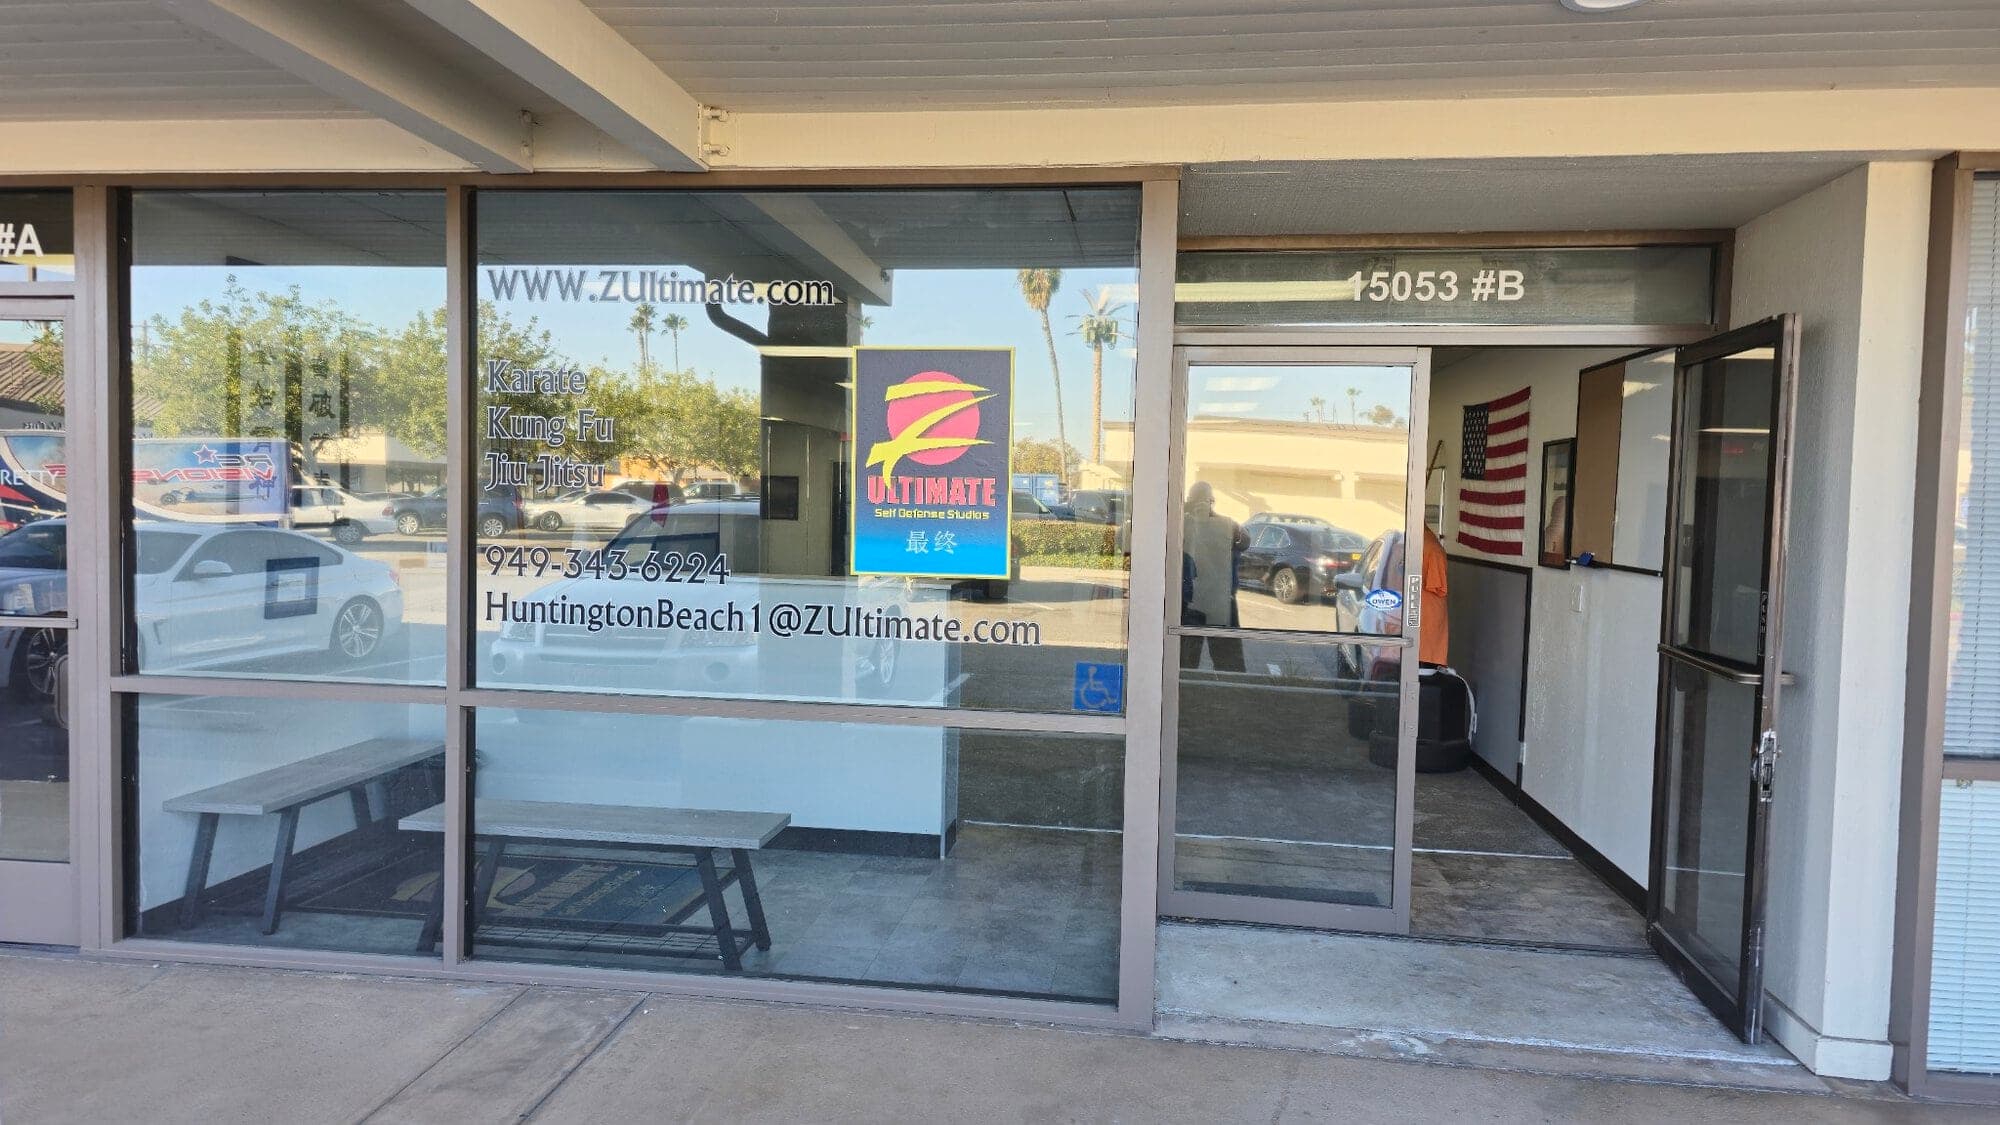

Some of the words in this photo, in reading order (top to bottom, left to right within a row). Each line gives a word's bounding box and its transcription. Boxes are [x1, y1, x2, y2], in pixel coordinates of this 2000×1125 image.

[0, 223, 45, 257] #A
[1348, 271, 1459, 301] 15053
[1471, 270, 1525, 301] #B
[487, 360, 585, 394] Karate
[487, 406, 565, 447] Kung
[577, 409, 614, 442] Fu
[485, 453, 528, 490] Jiu
[537, 454, 605, 491] Jitsu
[867, 475, 996, 506] ULTIMATE
[874, 508, 896, 518] Self
[898, 508, 945, 519] Defense
[947, 509, 990, 520] Studios
[905, 530, 958, 554] 最终
[485, 543, 731, 585] 949-343-6224
